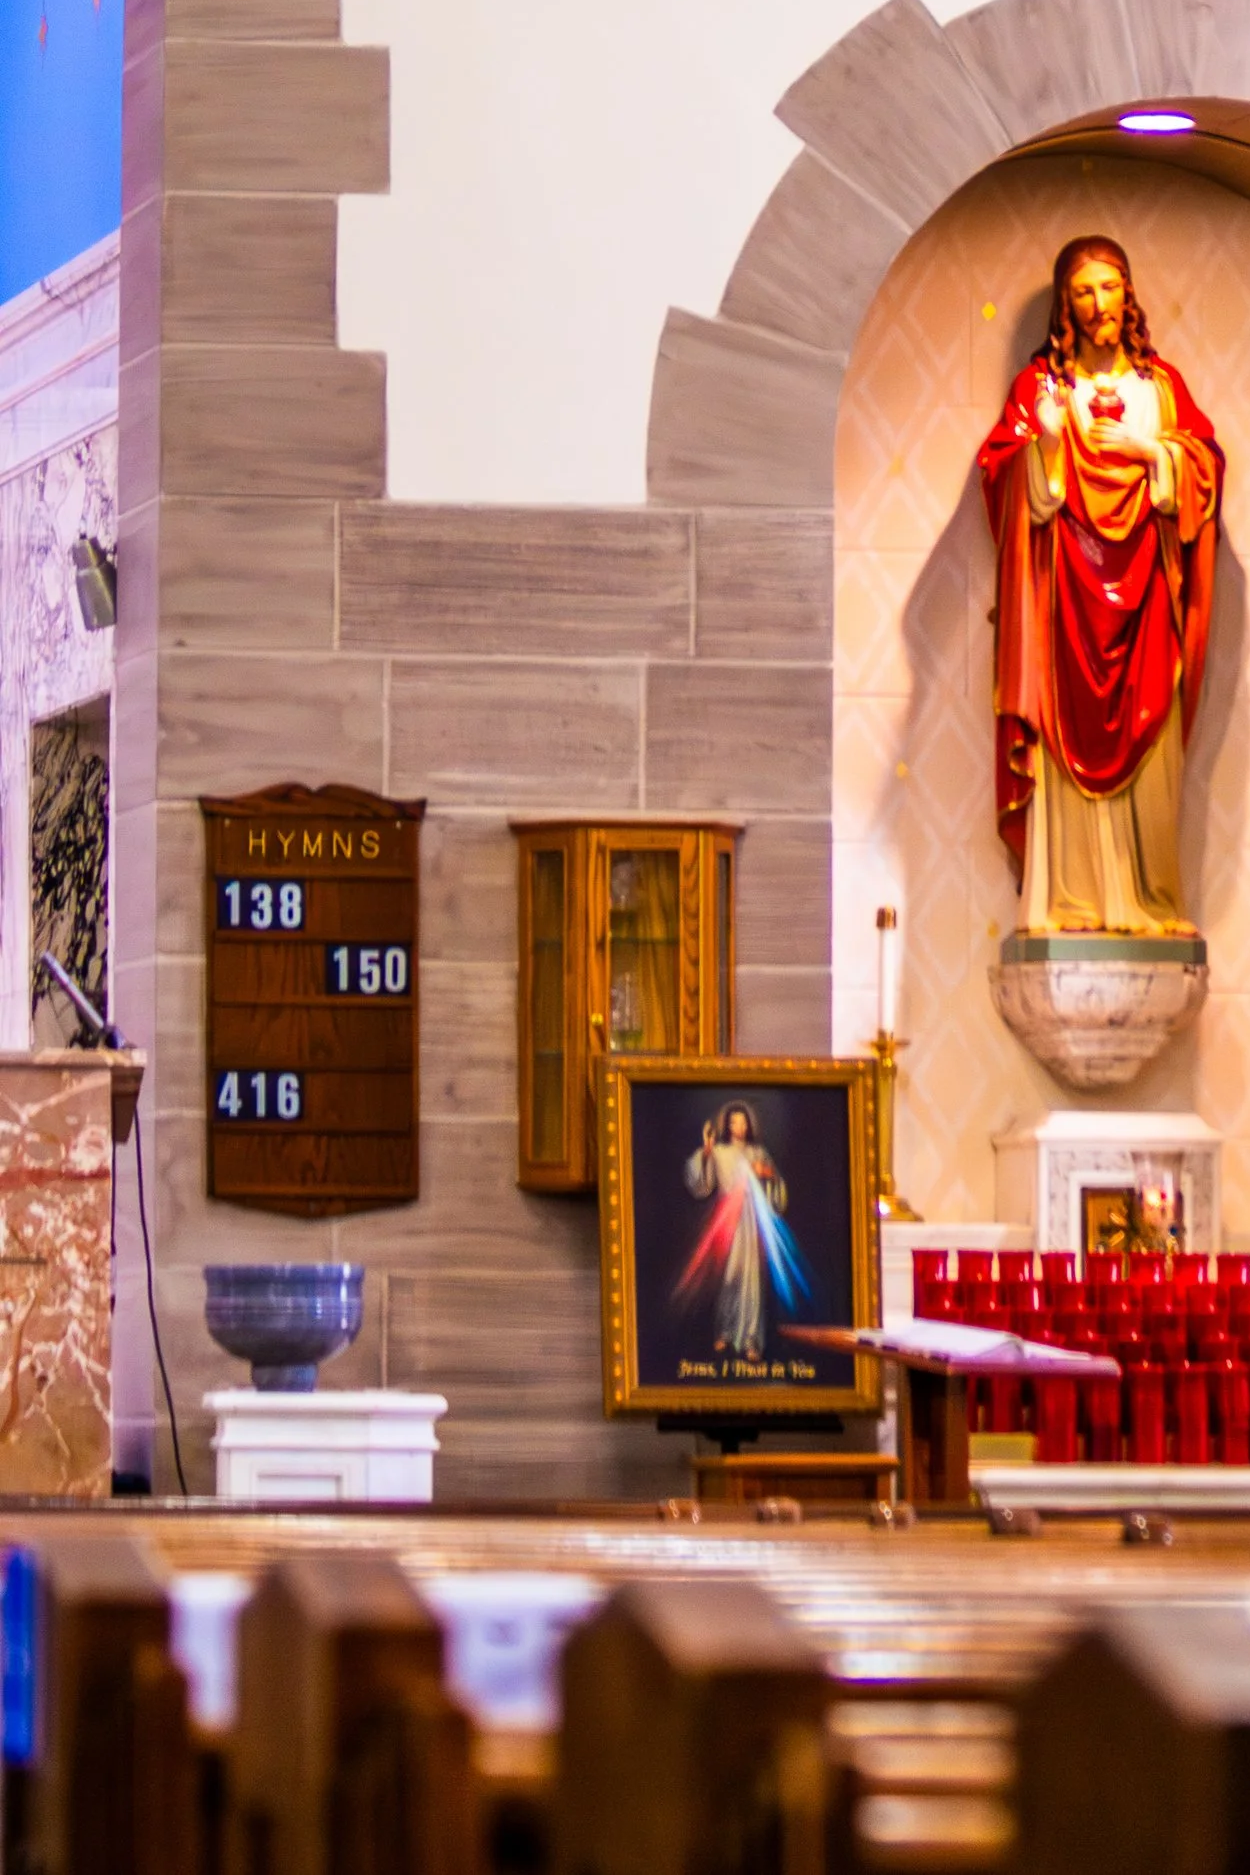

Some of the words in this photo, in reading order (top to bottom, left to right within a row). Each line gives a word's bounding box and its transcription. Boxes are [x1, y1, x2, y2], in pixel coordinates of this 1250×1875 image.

[248, 829, 381, 860] HYMNS
[225, 880, 302, 929] 138
[333, 946, 407, 995] 150
[218, 1071, 300, 1120] 416
